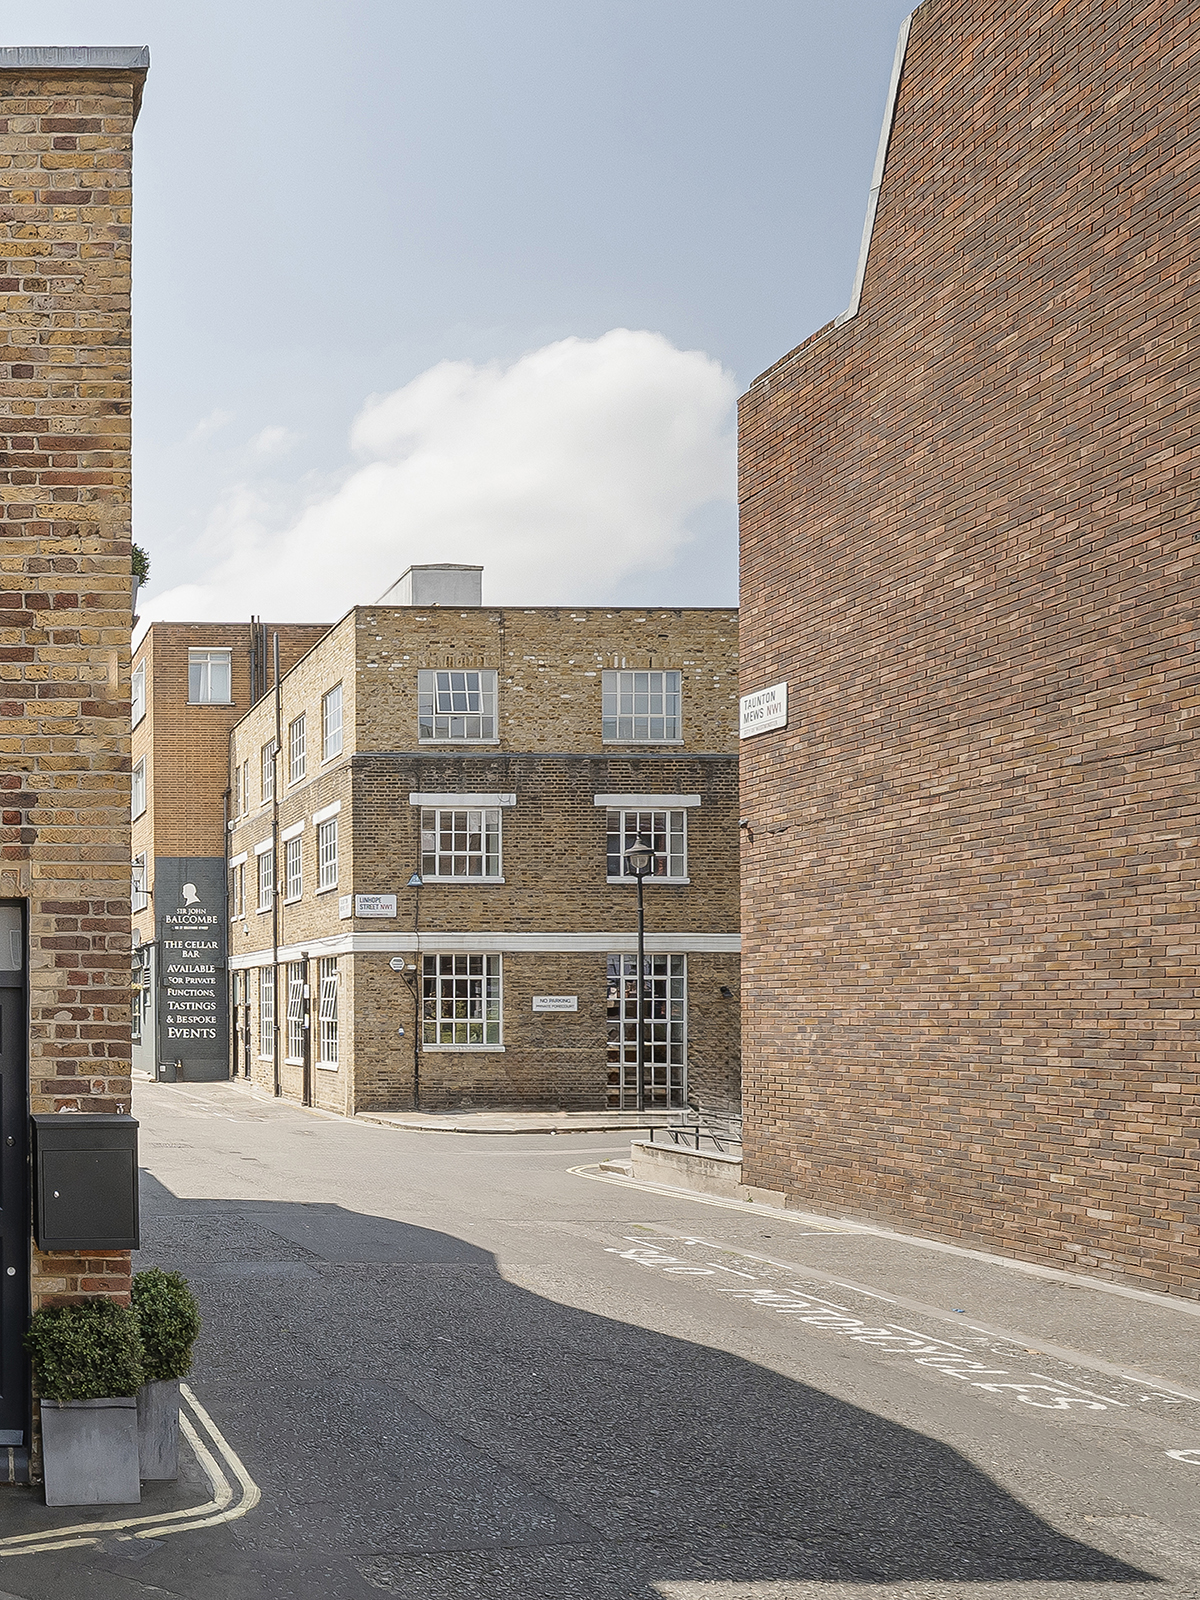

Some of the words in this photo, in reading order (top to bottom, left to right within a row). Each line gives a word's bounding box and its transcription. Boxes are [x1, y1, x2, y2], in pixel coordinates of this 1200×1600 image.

[744, 690, 776, 711] TAUNTON
[743, 707, 764, 724] MEWS
[766, 702, 782, 716] NW1
[165, 915, 218, 924] BALCOMBE
[164, 941, 183, 949] THE
[184, 941, 219, 949] CELLAR
[167, 964, 216, 973] AVAILABLE
[167, 1001, 217, 1010] TASTINGS
[166, 1015, 175, 1024] &
[176, 1015, 217, 1024] BESPOKE
[167, 1027, 217, 1039] EVENTS
[603, 1247, 716, 1276] SOLO
[716, 1288, 1108, 1411] MOTORCYCLES
